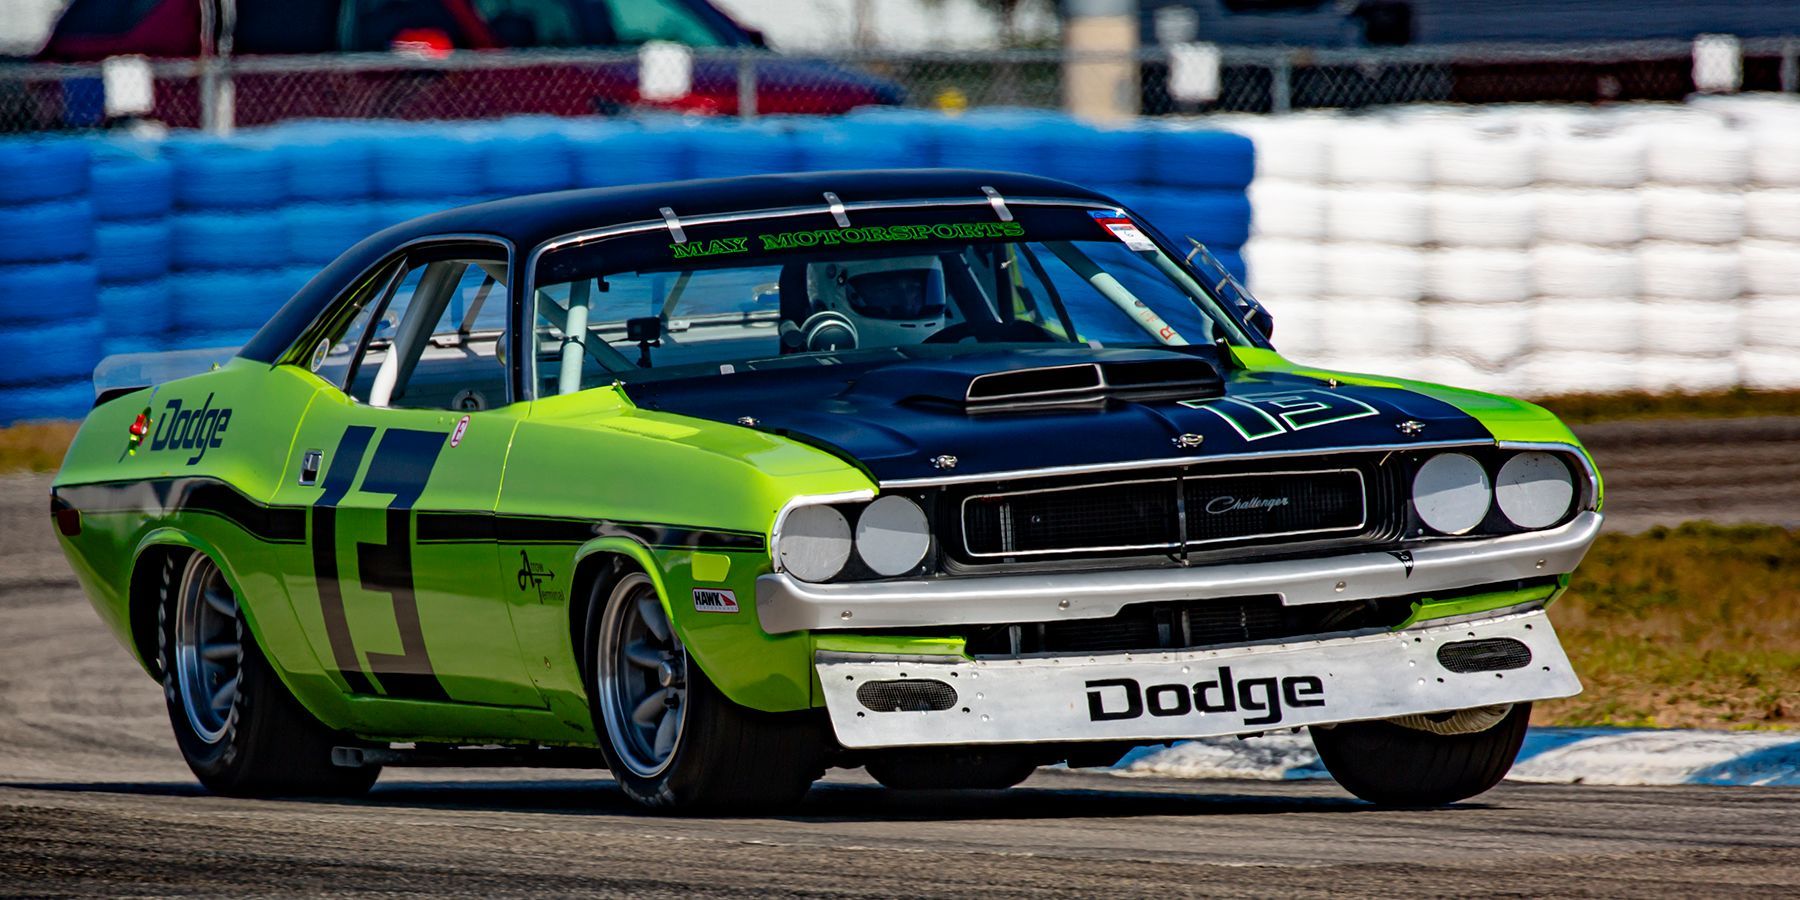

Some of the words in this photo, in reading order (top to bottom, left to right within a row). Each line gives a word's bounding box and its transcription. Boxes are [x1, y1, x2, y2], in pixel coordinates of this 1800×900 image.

[669, 236, 748, 259] MAY
[758, 220, 1025, 251] MOTORSPORTS
[151, 393, 232, 465] Dodge
[1176, 389, 1380, 442] 13
[1205, 494, 1289, 515] Challenger
[314, 425, 452, 699] 13
[694, 591, 722, 606] HAWK
[1085, 665, 1326, 726] Dodge
